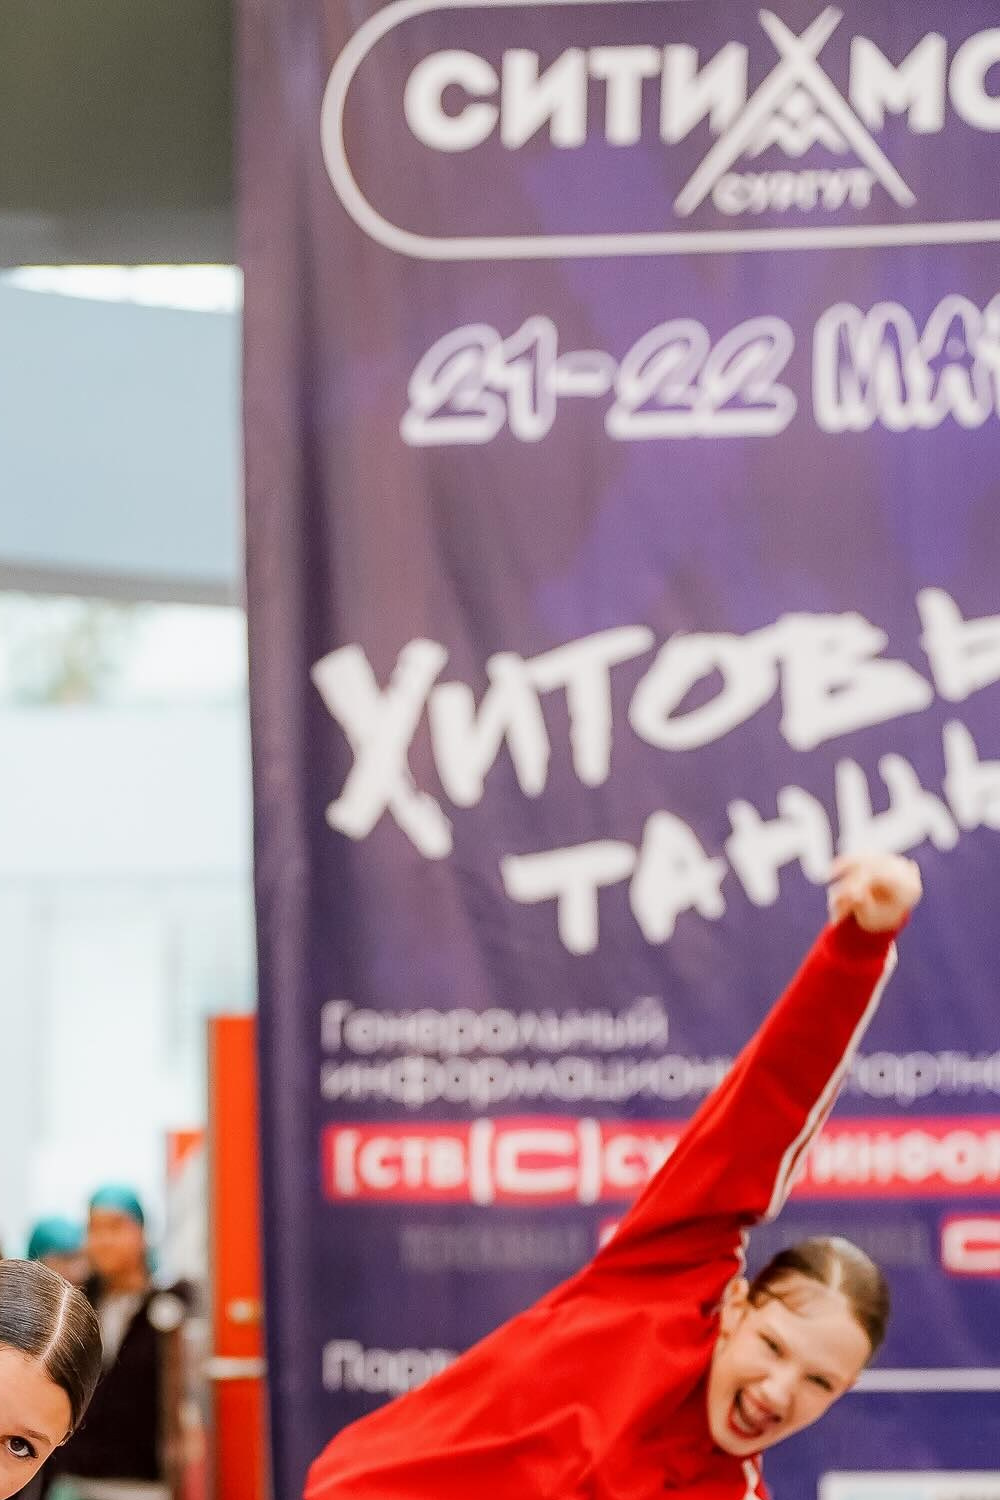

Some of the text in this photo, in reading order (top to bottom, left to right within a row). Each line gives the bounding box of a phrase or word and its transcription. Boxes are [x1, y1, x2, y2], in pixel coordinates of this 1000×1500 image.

[402, 293, 1000, 446] 21-22 МА
[319, 998, 669, 1055] Генеральный
